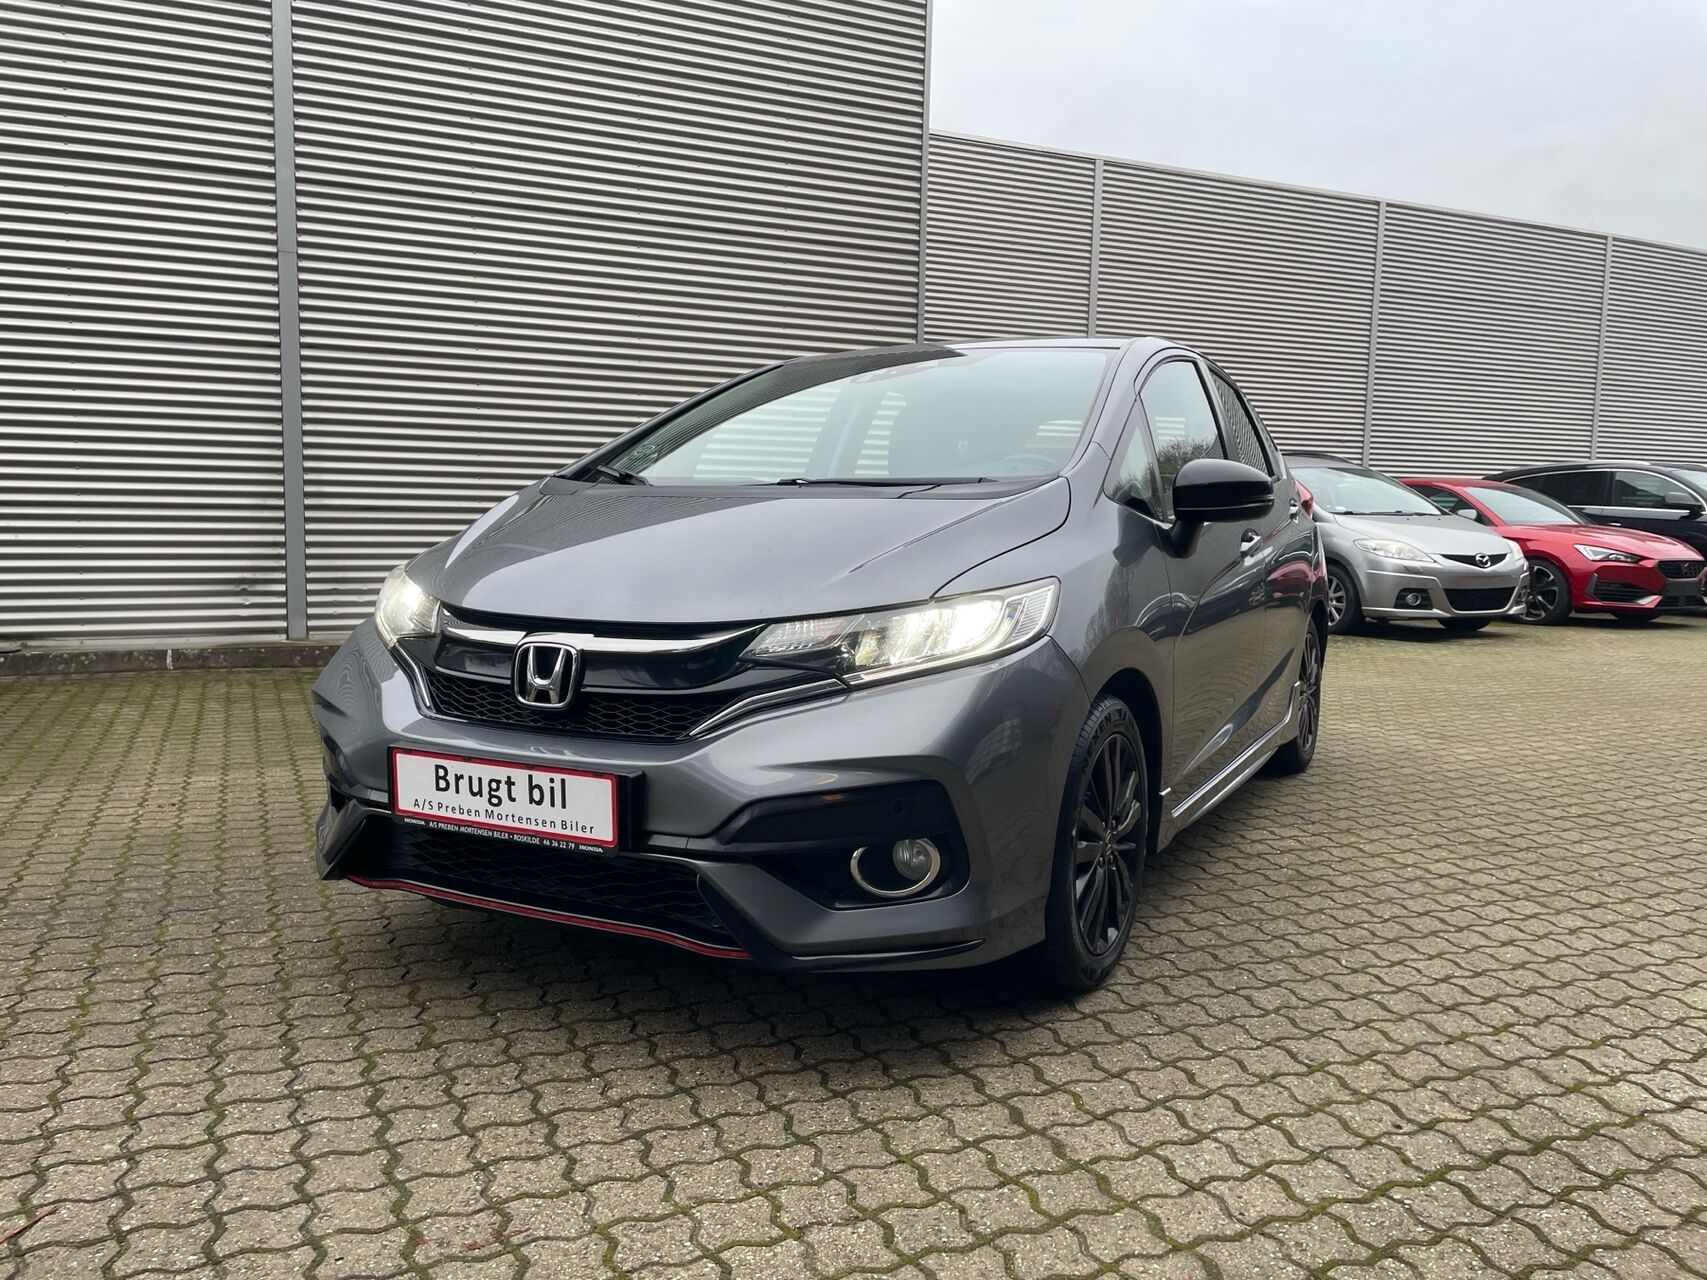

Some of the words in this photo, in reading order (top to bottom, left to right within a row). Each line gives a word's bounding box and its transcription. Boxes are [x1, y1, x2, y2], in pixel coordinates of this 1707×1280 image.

[434, 763, 517, 808] Brugt
[528, 773, 568, 809] bil
[413, 798, 434, 811] A/S
[437, 801, 481, 819] Preben
[485, 808, 556, 829] Mortensen
[561, 819, 595, 834] Biler
[404, 817, 426, 826] HONDA
[429, 821, 438, 829] A/S
[438, 822, 459, 832] PREBEN
[459, 825, 493, 837] MORTENSEN
[493, 831, 509, 840] BILER
[513, 833, 541, 845] ROSKILDE
[559, 841, 567, 849] 22
[579, 844, 604, 853] HONDA
